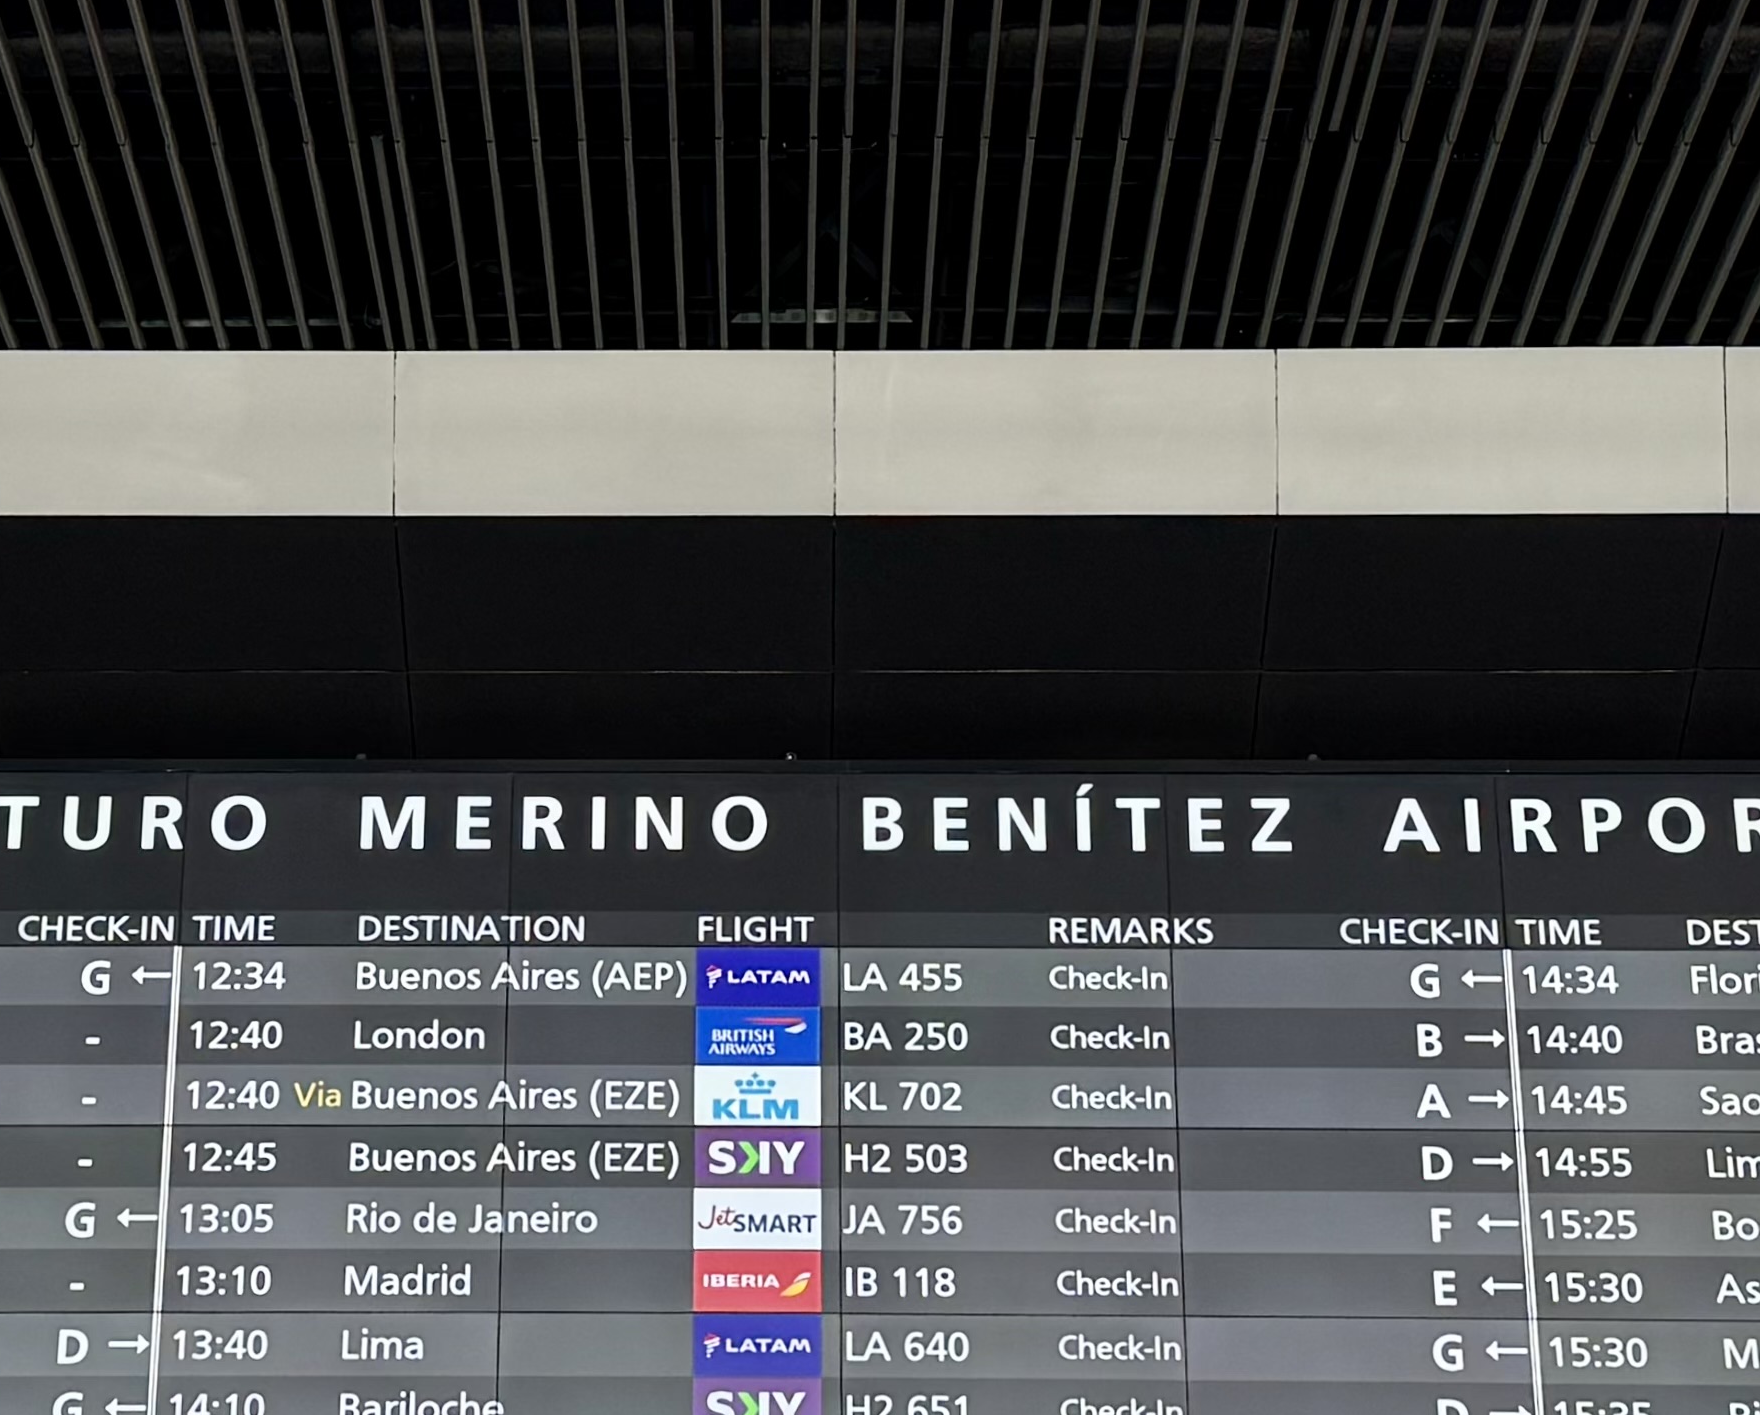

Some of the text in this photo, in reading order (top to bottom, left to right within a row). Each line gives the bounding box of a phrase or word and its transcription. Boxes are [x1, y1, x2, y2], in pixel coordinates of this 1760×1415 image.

[360, 796, 767, 851] MERINO
[863, 784, 1292, 852] BENÍTEZ
[18, 916, 174, 941] CHECK-IN
[82, 961, 110, 994] G
[194, 960, 1440, 998] 12:34 Buenos Aires (AEP) LATAM LA 455 Check-In G
[1523, 966, 1619, 994] 14:34
[1541, 1210, 1637, 1239] 15:25
[177, 1264, 779, 1295] 13:10 Madrid IBERIA
